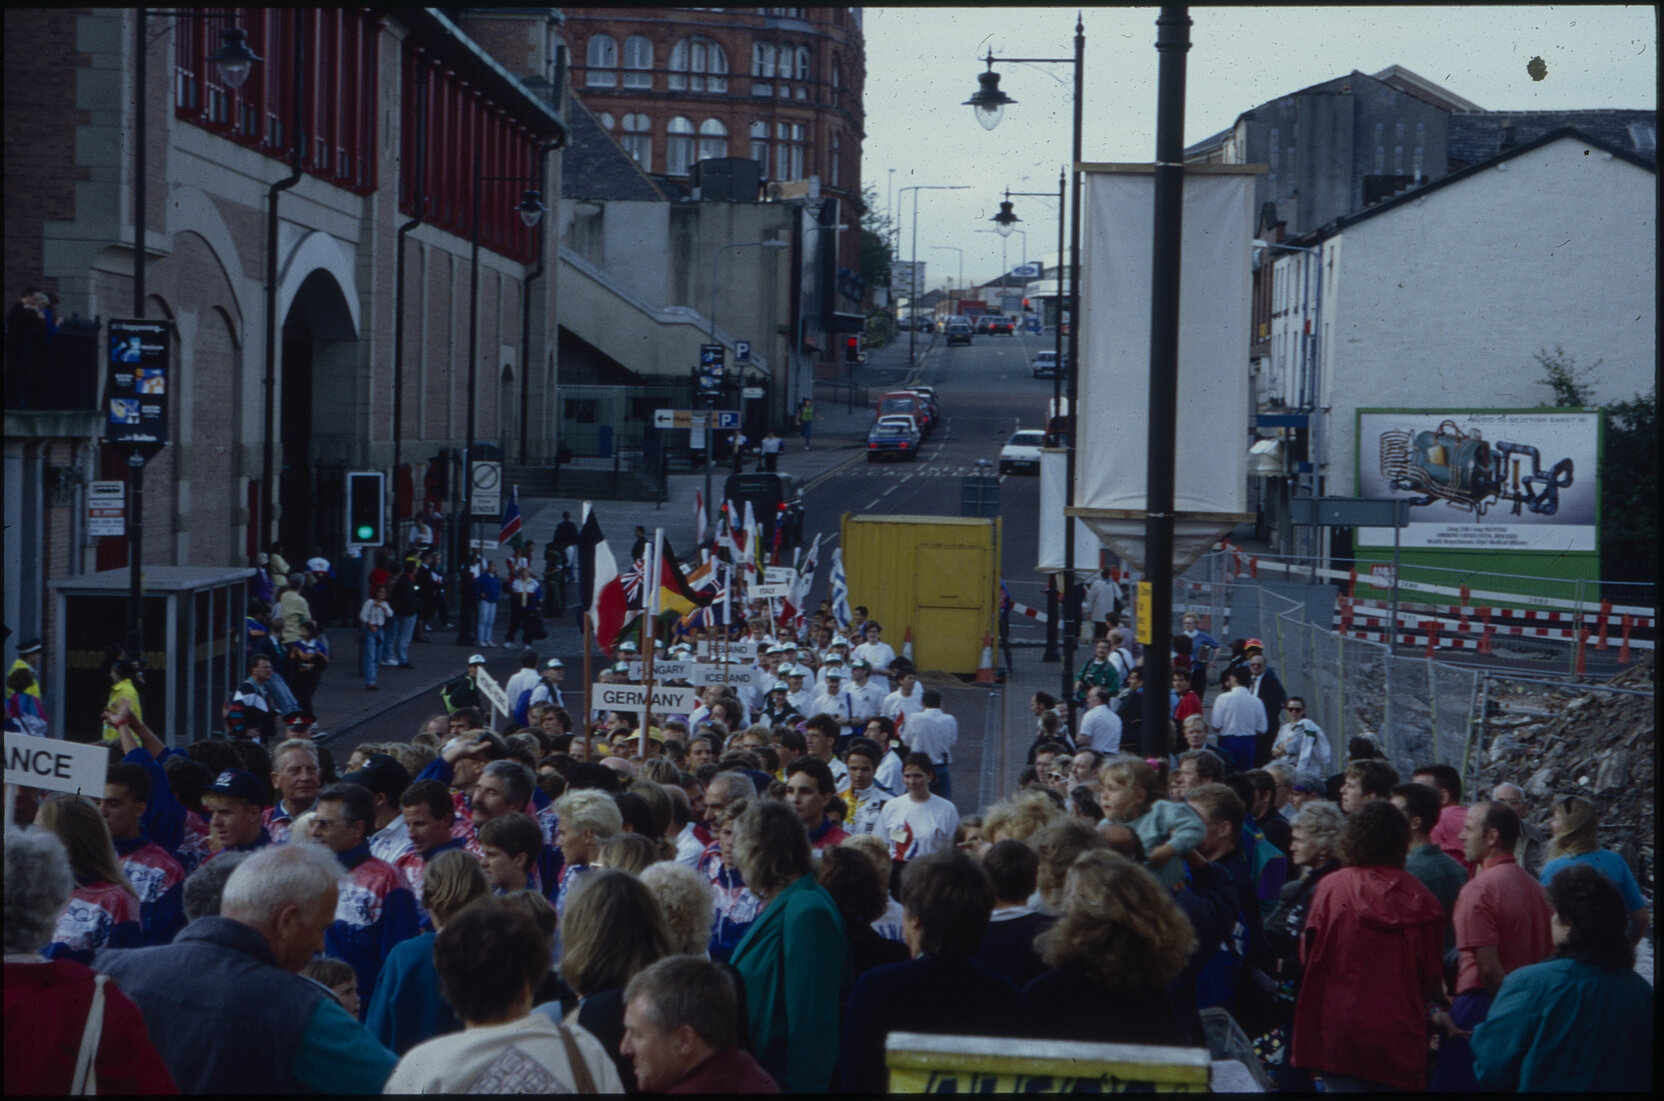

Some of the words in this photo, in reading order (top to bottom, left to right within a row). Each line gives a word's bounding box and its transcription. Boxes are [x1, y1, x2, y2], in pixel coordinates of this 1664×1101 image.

[736, 343, 748, 358] P
[721, 414, 732, 426] P
[759, 587, 776, 595] ITALY
[707, 644, 748, 655] RELAND
[637, 664, 686, 675] HNGARY
[603, 690, 684, 707] GERMANY
